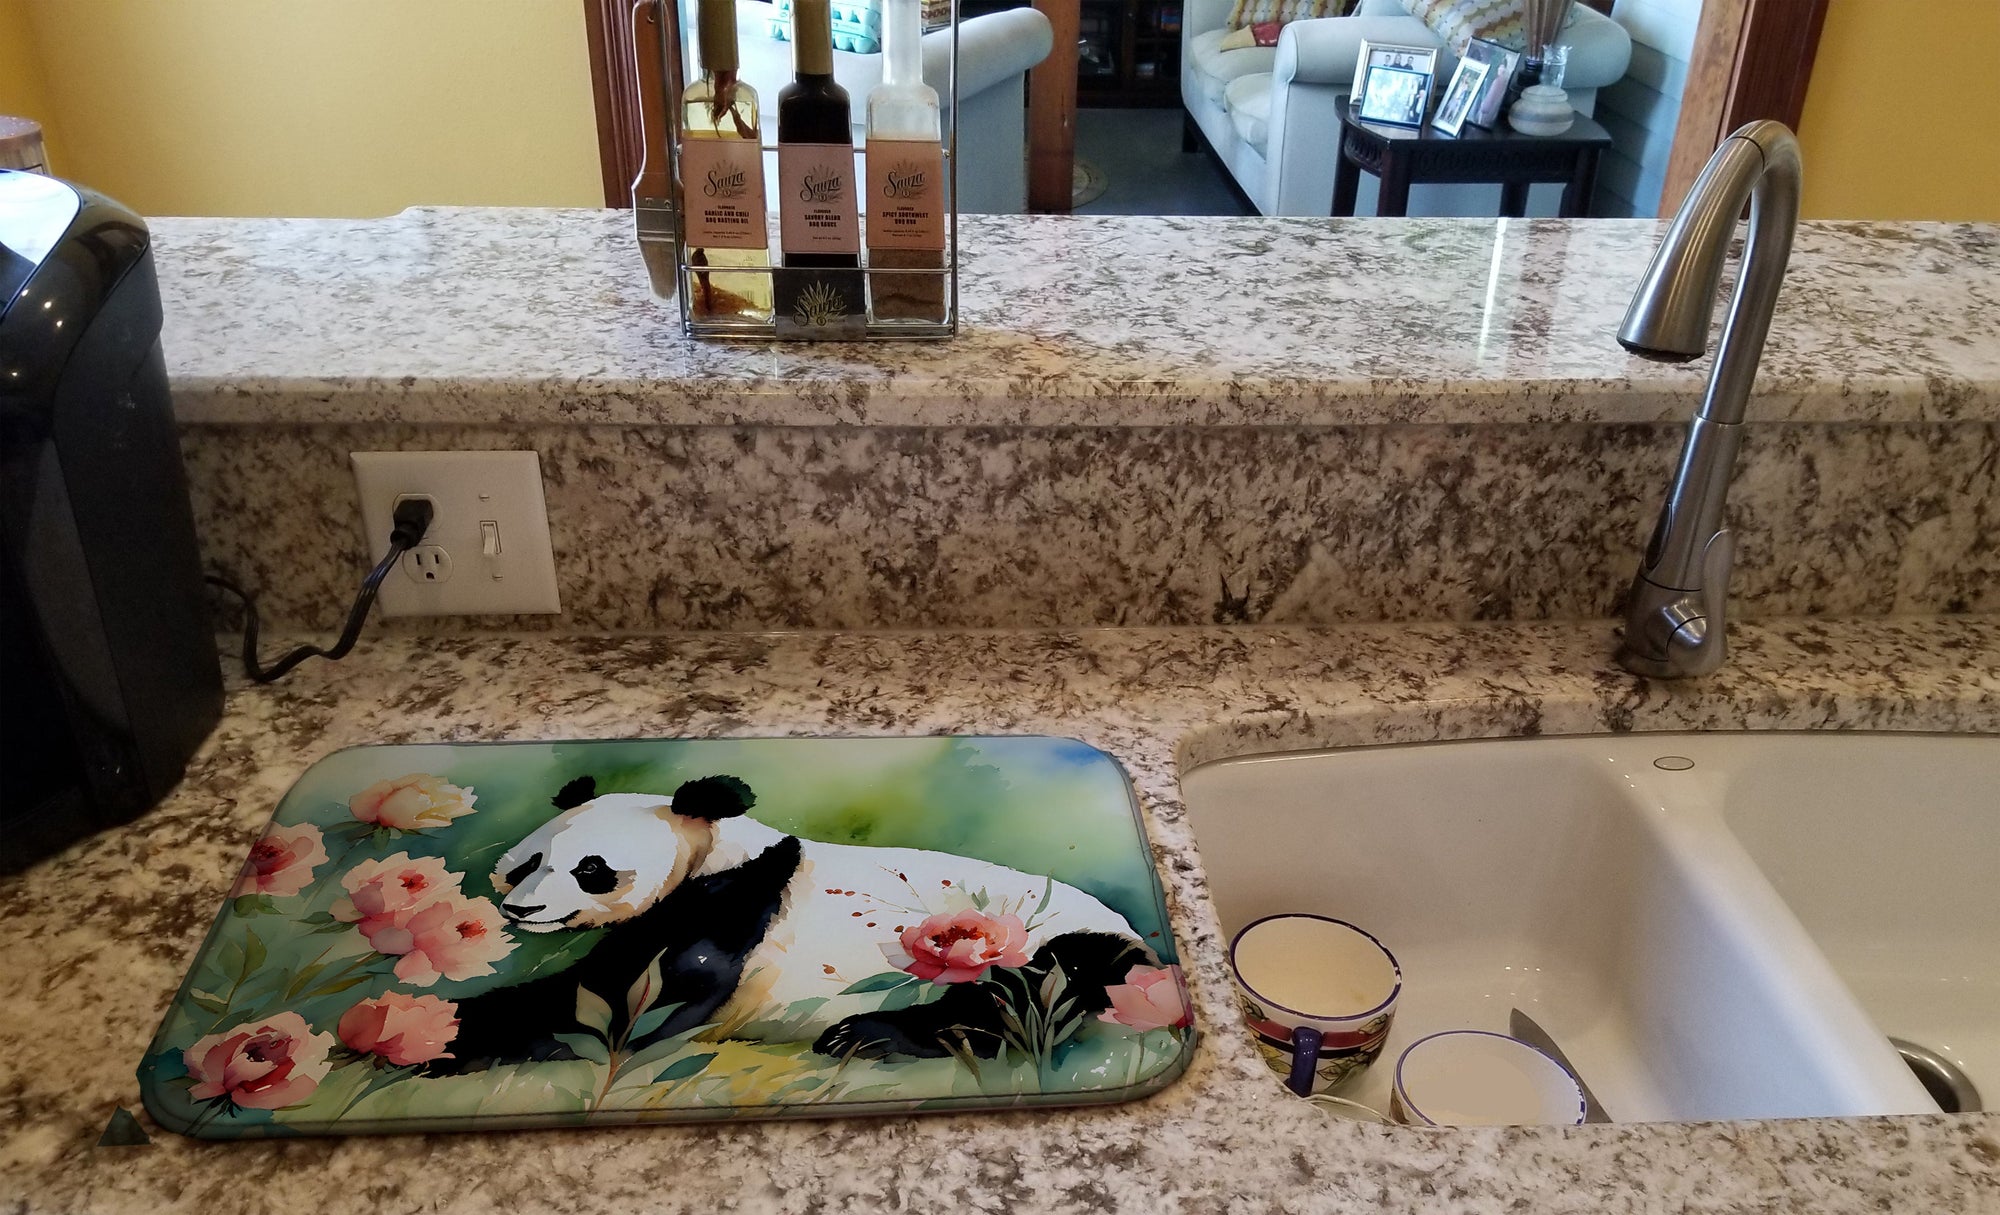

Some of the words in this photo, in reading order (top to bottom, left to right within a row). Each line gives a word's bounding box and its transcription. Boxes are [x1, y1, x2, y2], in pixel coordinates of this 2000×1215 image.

[703, 170, 745, 197] Sauza
[800, 175, 841, 202] Sauza
[883, 171, 925, 198] Sauza
[793, 295, 843, 327] Sauza
